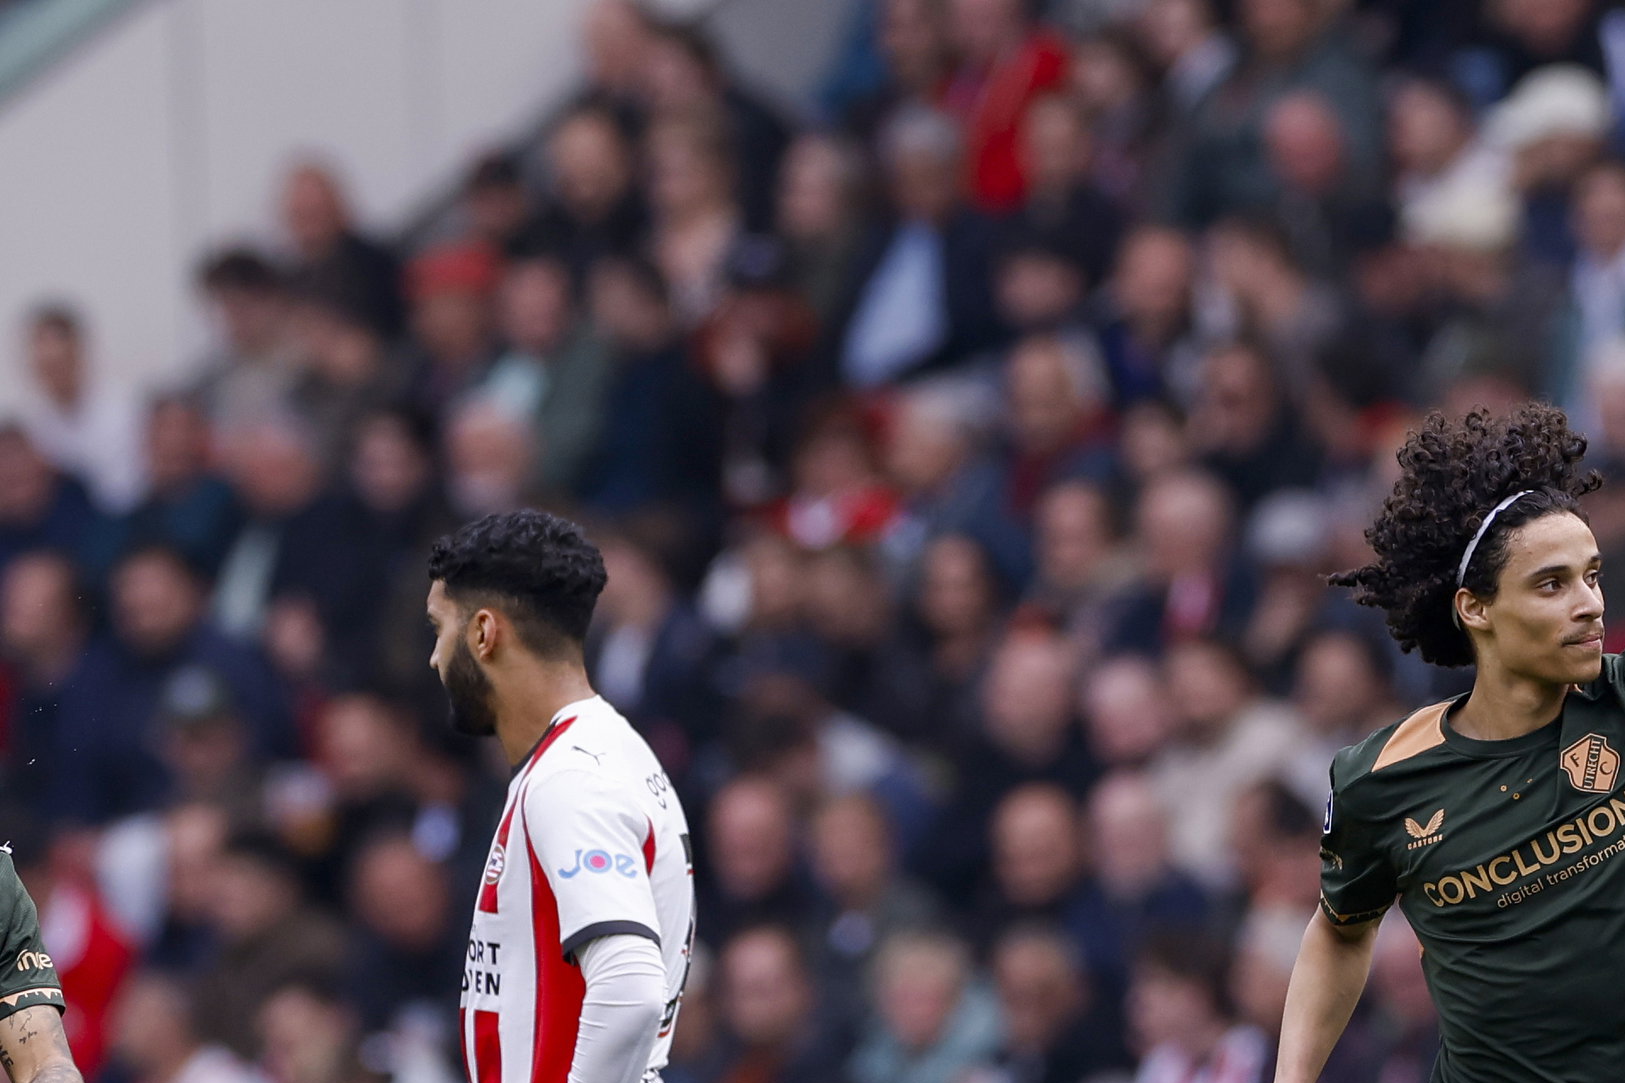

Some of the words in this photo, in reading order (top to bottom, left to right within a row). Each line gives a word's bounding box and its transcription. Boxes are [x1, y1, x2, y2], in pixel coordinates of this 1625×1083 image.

[1570, 752, 1580, 768] F
[1583, 738, 1602, 789] UTRECHT
[1600, 761, 1613, 775] C
[1407, 834, 1443, 850] CASTORE
[1497, 879, 1544, 908] digital
